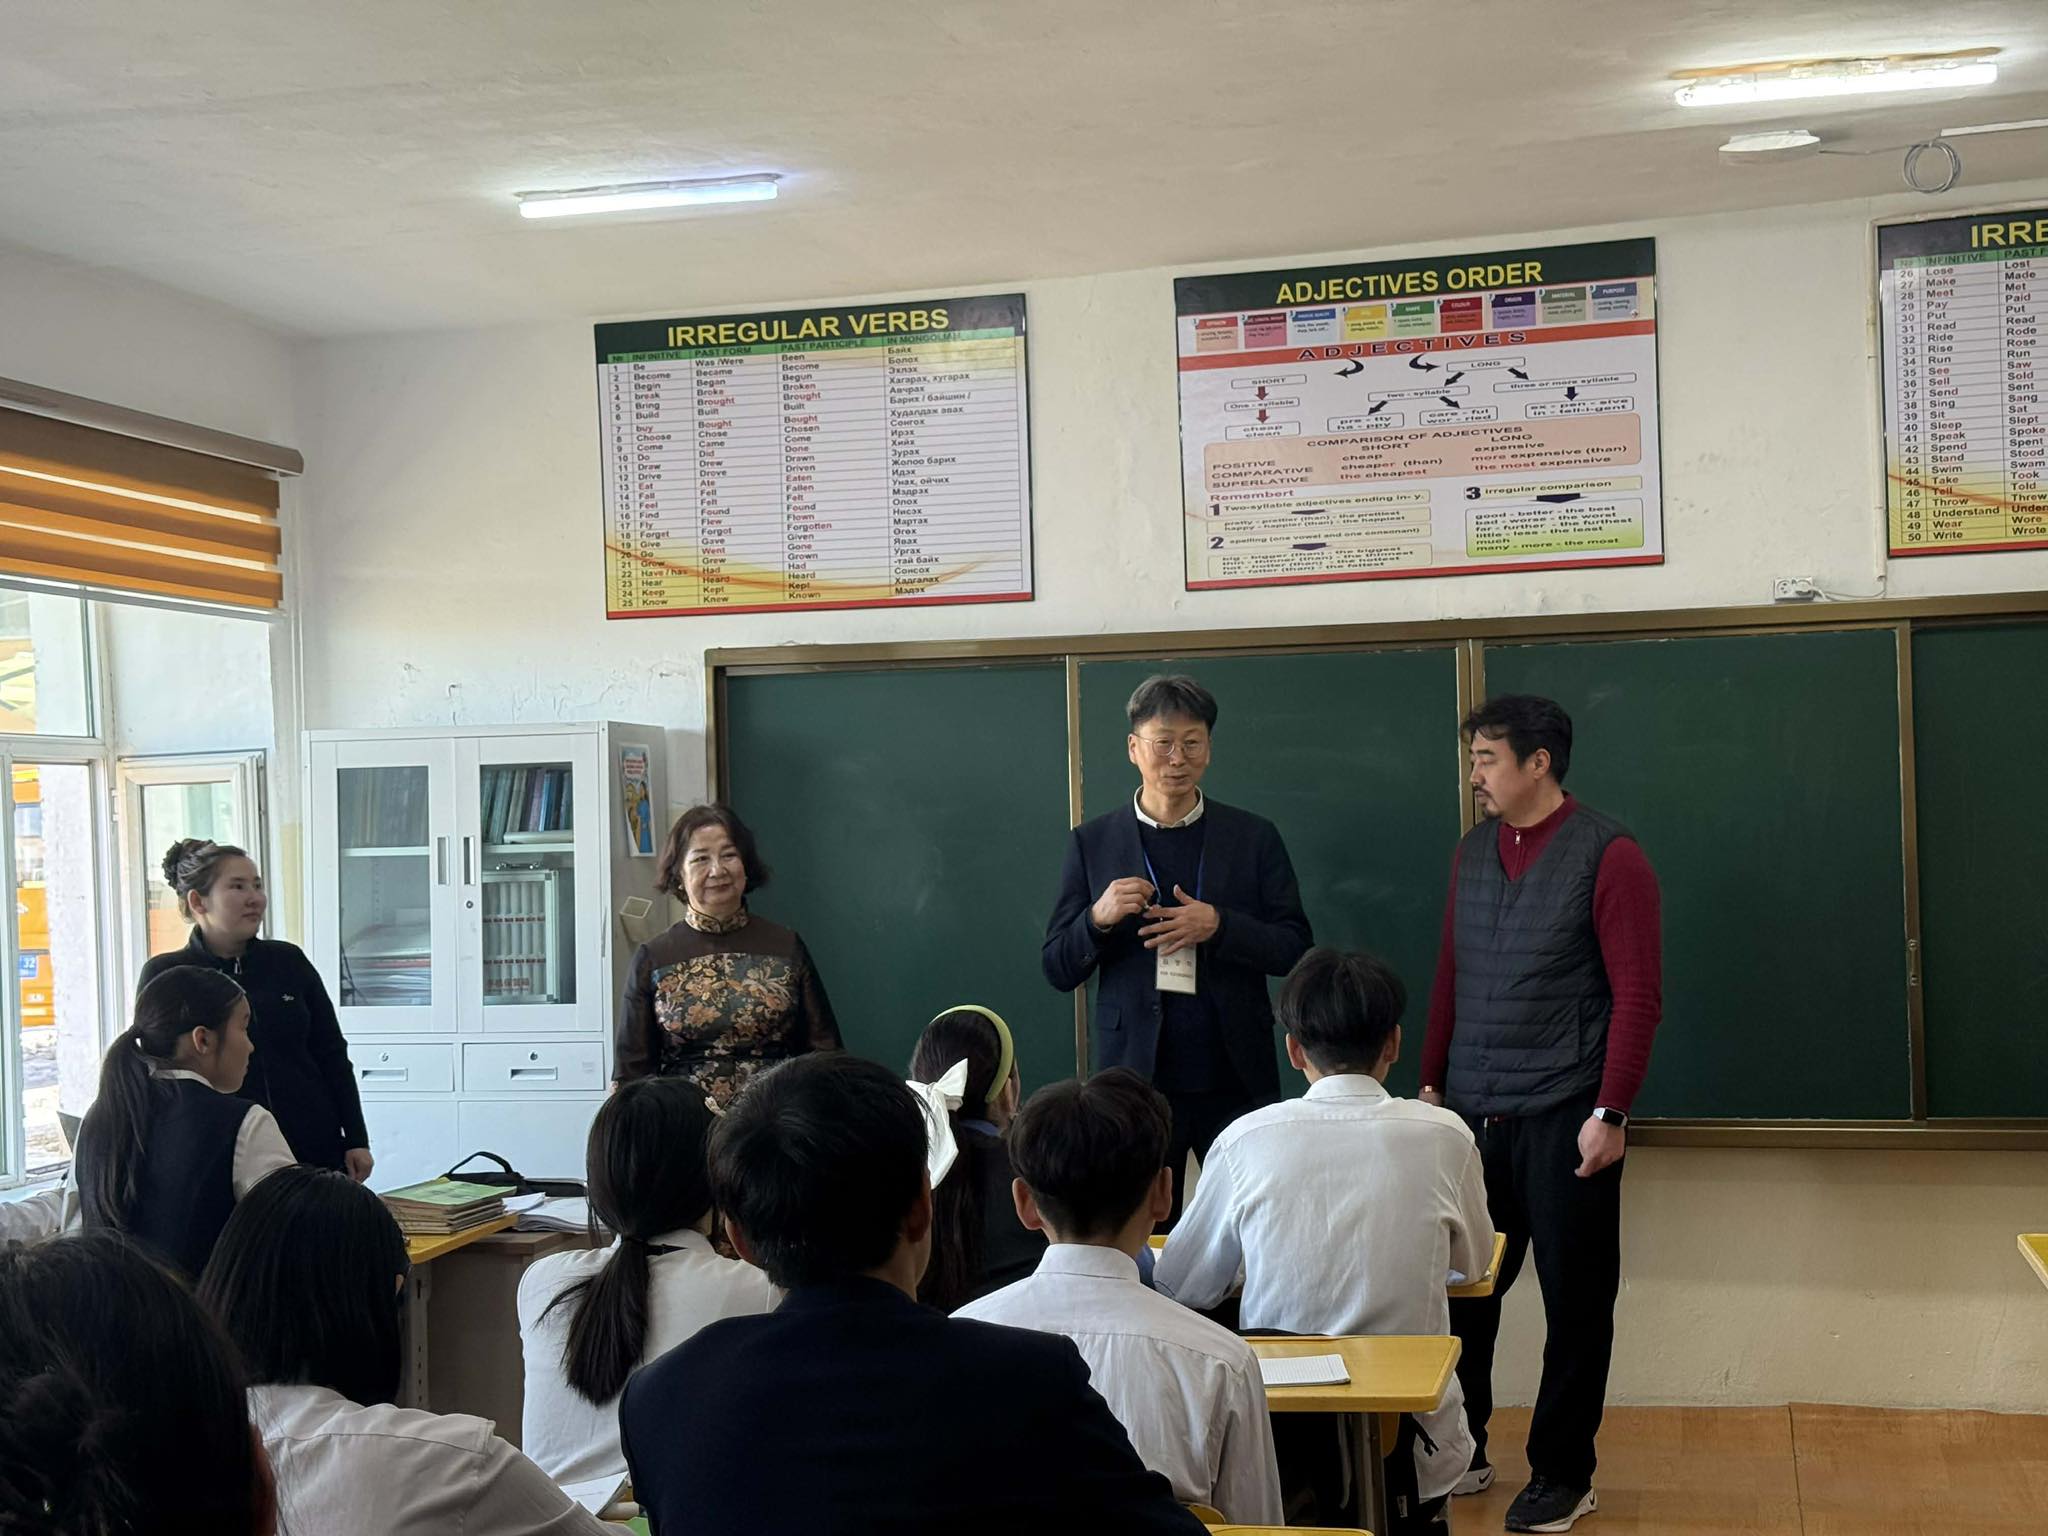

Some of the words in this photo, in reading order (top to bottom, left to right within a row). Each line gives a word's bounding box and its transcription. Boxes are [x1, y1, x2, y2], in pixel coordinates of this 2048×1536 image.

[2003, 247, 2035, 259] PAST
[2003, 259, 2030, 270] Lost
[1925, 266, 1954, 276] Lose
[2004, 270, 2036, 280] Made
[1275, 270, 1438, 304] ADJECTIVES
[1446, 261, 1542, 289] ORDER
[1925, 277, 1956, 287] Make
[2004, 282, 2026, 291] Met
[1900, 291, 1914, 300] 28
[1925, 287, 1954, 298] Meet
[2004, 292, 2031, 303] Paid
[1925, 300, 1948, 310] Pay
[2005, 304, 2025, 314] Put
[1926, 311, 1946, 320] Put
[2005, 314, 2036, 325] Read
[667, 316, 839, 347] IRREGULAR
[848, 307, 949, 334] VERBS
[1926, 320, 1957, 331] Read
[2005, 325, 2037, 336] Rode
[1901, 334, 1915, 345] 32
[1927, 332, 1954, 343] Ride
[2006, 338, 2036, 347] Rose
[779, 342, 807, 352] PAST
[809, 338, 863, 349] PARTICIPLE
[1297, 330, 1527, 361] ADJECTIVES
[1927, 344, 1953, 353] Rise
[631, 350, 681, 362] INFINITIVE
[694, 348, 719, 357] PAST
[721, 345, 752, 355] FORM
[2006, 349, 2031, 358] Run
[780, 353, 805, 362] Been
[1927, 355, 1951, 364] Run
[632, 363, 646, 371] Be
[781, 363, 820, 372] Become
[1469, 359, 1502, 369] LONG
[2006, 360, 2032, 370] Saw
[695, 368, 733, 377] Became
[1927, 366, 1950, 376] See
[2007, 370, 2034, 381] Sold
[633, 372, 671, 381] Become
[1250, 376, 1287, 386] SHORT
[1509, 380, 1537, 389] three
[1551, 378, 1578, 386] more
[1580, 374, 1620, 385] syllable
[1928, 376, 1950, 387] Sell
[633, 382, 661, 391] Begin
[695, 378, 726, 387] Began
[781, 382, 816, 391] Broken
[1903, 379, 1917, 389] 36
[2007, 381, 2034, 392] Sent
[1928, 386, 1959, 397] Send
[889, 395, 919, 405] Барих
[2007, 393, 2038, 403] Sang
[634, 401, 660, 410] Bring
[1229, 401, 1249, 410] One
[1256, 398, 1295, 409] syllable
[1928, 399, 1955, 409] Sing
[2007, 404, 2028, 414] Sat
[1929, 410, 1945, 419] Sit
[2008, 414, 2039, 425] Slept
[889, 418, 925, 427] Сонгох
[1903, 423, 1918, 432] 40
[1929, 421, 1962, 430] Sleep
[2008, 425, 2046, 437] Spoke
[635, 433, 672, 442] Choose
[783, 434, 812, 444] Come
[1307, 434, 1403, 447] COMPARISON
[1407, 432, 1427, 441] OF
[1432, 426, 1522, 438] ADJECTIVES
[1490, 433, 1533, 443] LONG
[1930, 431, 1965, 442] Speak
[697, 439, 725, 448] Came
[1360, 441, 1411, 452] SHORT
[1474, 441, 1545, 453] expensive
[1930, 441, 1967, 453] Spend
[2009, 437, 2043, 447] Spent
[636, 443, 664, 452] Come
[2009, 447, 2045, 458] Stood
[698, 449, 715, 458] Did
[891, 448, 920, 458] Зурах
[1341, 452, 1383, 463] cheap
[1470, 453, 1507, 462] more
[1510, 448, 1582, 459] expensive
[1584, 444, 1628, 455] (than)
[1930, 452, 1965, 463] Stand
[891, 458, 925, 466] Жолоо
[926, 456, 956, 465] барих
[1211, 459, 1276, 471] POSITIVE
[1340, 460, 1396, 472] cheaper
[1402, 456, 1444, 468] (than)
[1474, 462, 1497, 471] the
[1500, 460, 1537, 469] most
[1540, 456, 1610, 467] expensive
[2009, 460, 2046, 469] Swam
[637, 462, 661, 471] Draw
[784, 464, 816, 473] Driven
[1905, 466, 1919, 475] 44
[1931, 464, 1963, 474] Swim
[637, 472, 662, 481] Drive
[1212, 466, 1313, 479] COMPARATIVE
[1339, 471, 1361, 481] the
[1365, 468, 1426, 479] cheapest
[2009, 469, 2040, 480] Took
[1212, 476, 1308, 488] SUPERLATIVE
[1930, 475, 1959, 485] Take
[1466, 486, 1481, 500] 3
[1484, 484, 1537, 496] irregular
[1539, 480, 1611, 491] comparison
[1931, 485, 1953, 496] Tell
[2010, 481, 2037, 491] Told
[1931, 495, 1969, 507] Throw
[2010, 490, 2048, 502] Threw
[891, 497, 918, 506] Олох
[1209, 503, 1220, 516] 1
[1223, 501, 1291, 512] Two-syllable
[1295, 496, 1352, 508] adjectives
[1353, 494, 1393, 505] ending
[638, 510, 660, 519] Find
[700, 506, 730, 516] Found
[892, 507, 922, 515] Нисэх
[1474, 511, 1507, 520] good
[1517, 508, 1554, 517] better
[1587, 504, 1616, 512] best
[1581, 511, 1616, 520] worst
[1906, 510, 1921, 519] 48
[1933, 505, 1999, 518] Understand
[892, 517, 928, 527] Мартах
[1583, 516, 1632, 526] furthest
[1931, 519, 1963, 529] Wear
[2010, 515, 2042, 524] Wore
[700, 526, 732, 536] Forgot
[786, 522, 832, 532] Forgotten
[2011, 525, 2046, 535] Wrote
[639, 529, 670, 539] Forget
[786, 532, 815, 541] Given
[1932, 530, 1963, 540] Write
[892, 537, 918, 545] Явах
[1210, 536, 1224, 548] 2
[1475, 543, 1510, 552] many
[1586, 537, 1619, 545] most
[786, 552, 818, 561] Grown
[893, 546, 921, 557] Ургах
[701, 556, 727, 565] Grew
[893, 565, 930, 575] Сонсох
[787, 591, 821, 599] Known
[641, 598, 669, 606] Know
